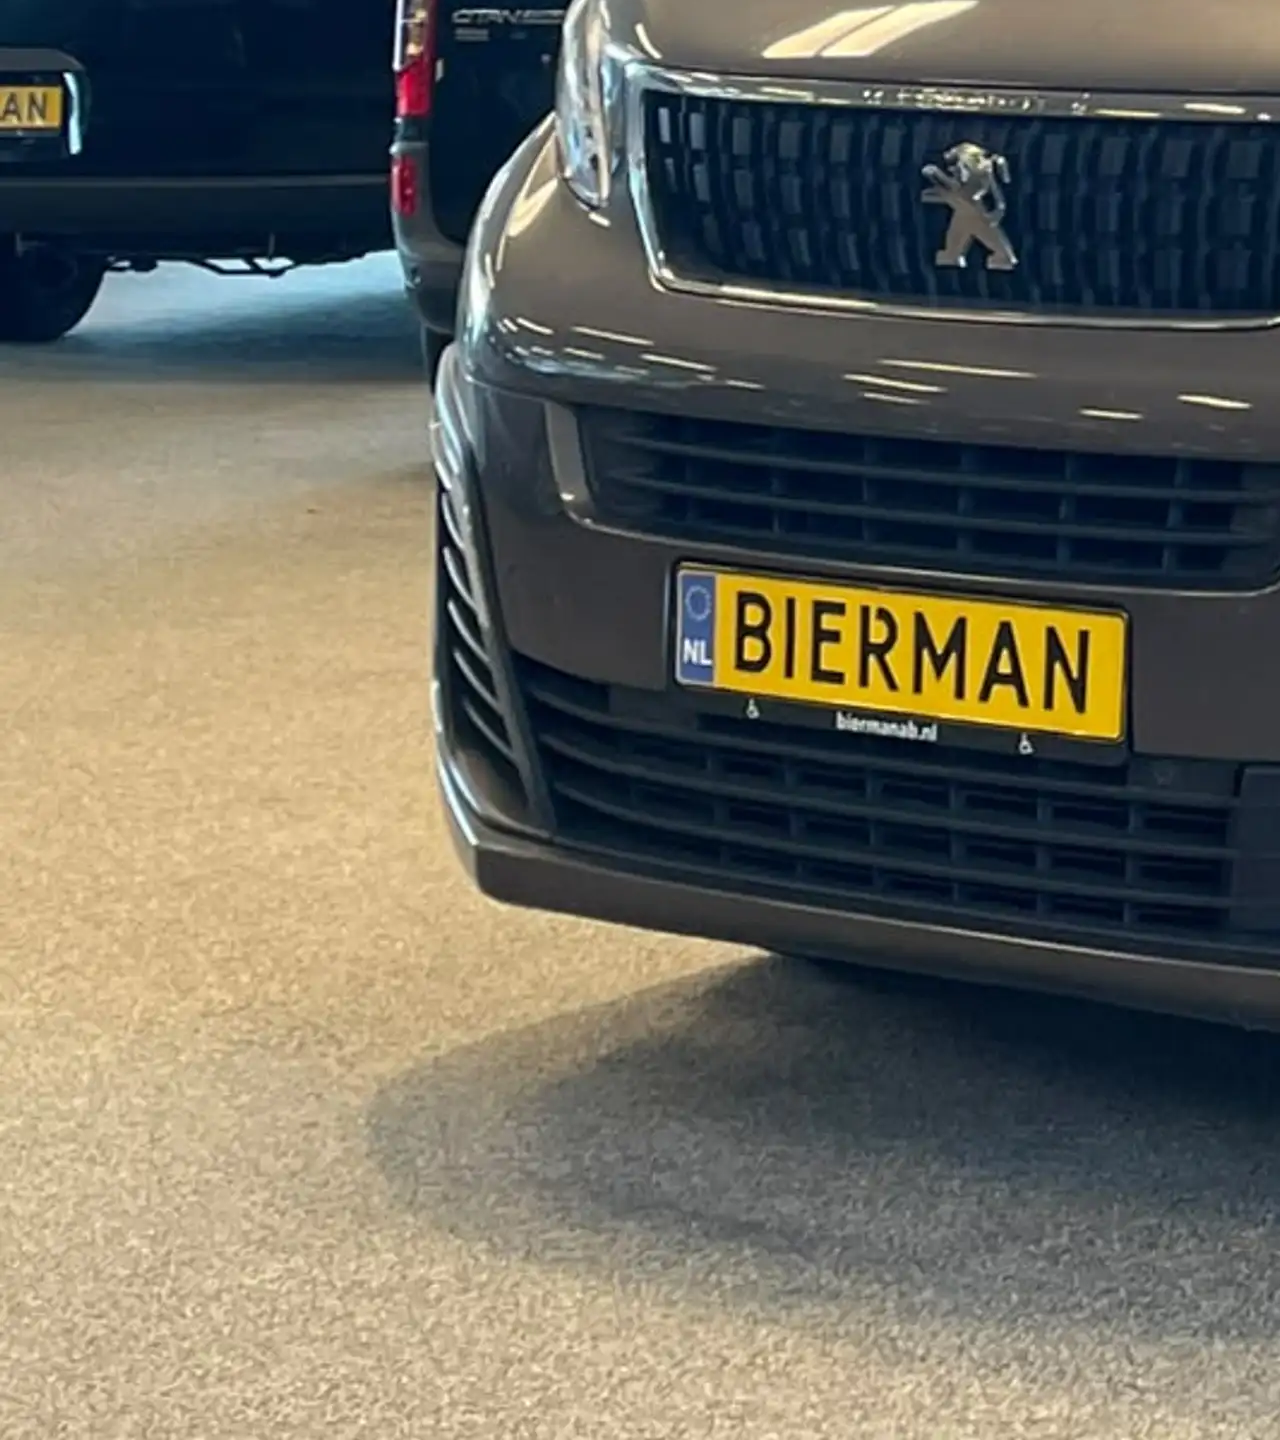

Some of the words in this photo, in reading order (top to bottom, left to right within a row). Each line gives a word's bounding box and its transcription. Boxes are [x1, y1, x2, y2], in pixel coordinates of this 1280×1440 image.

[0, 91, 48, 122] AN
[683, 637, 713, 667] NL
[734, 591, 1090, 715] BIERMAN
[835, 711, 938, 743] biermanab.nl
